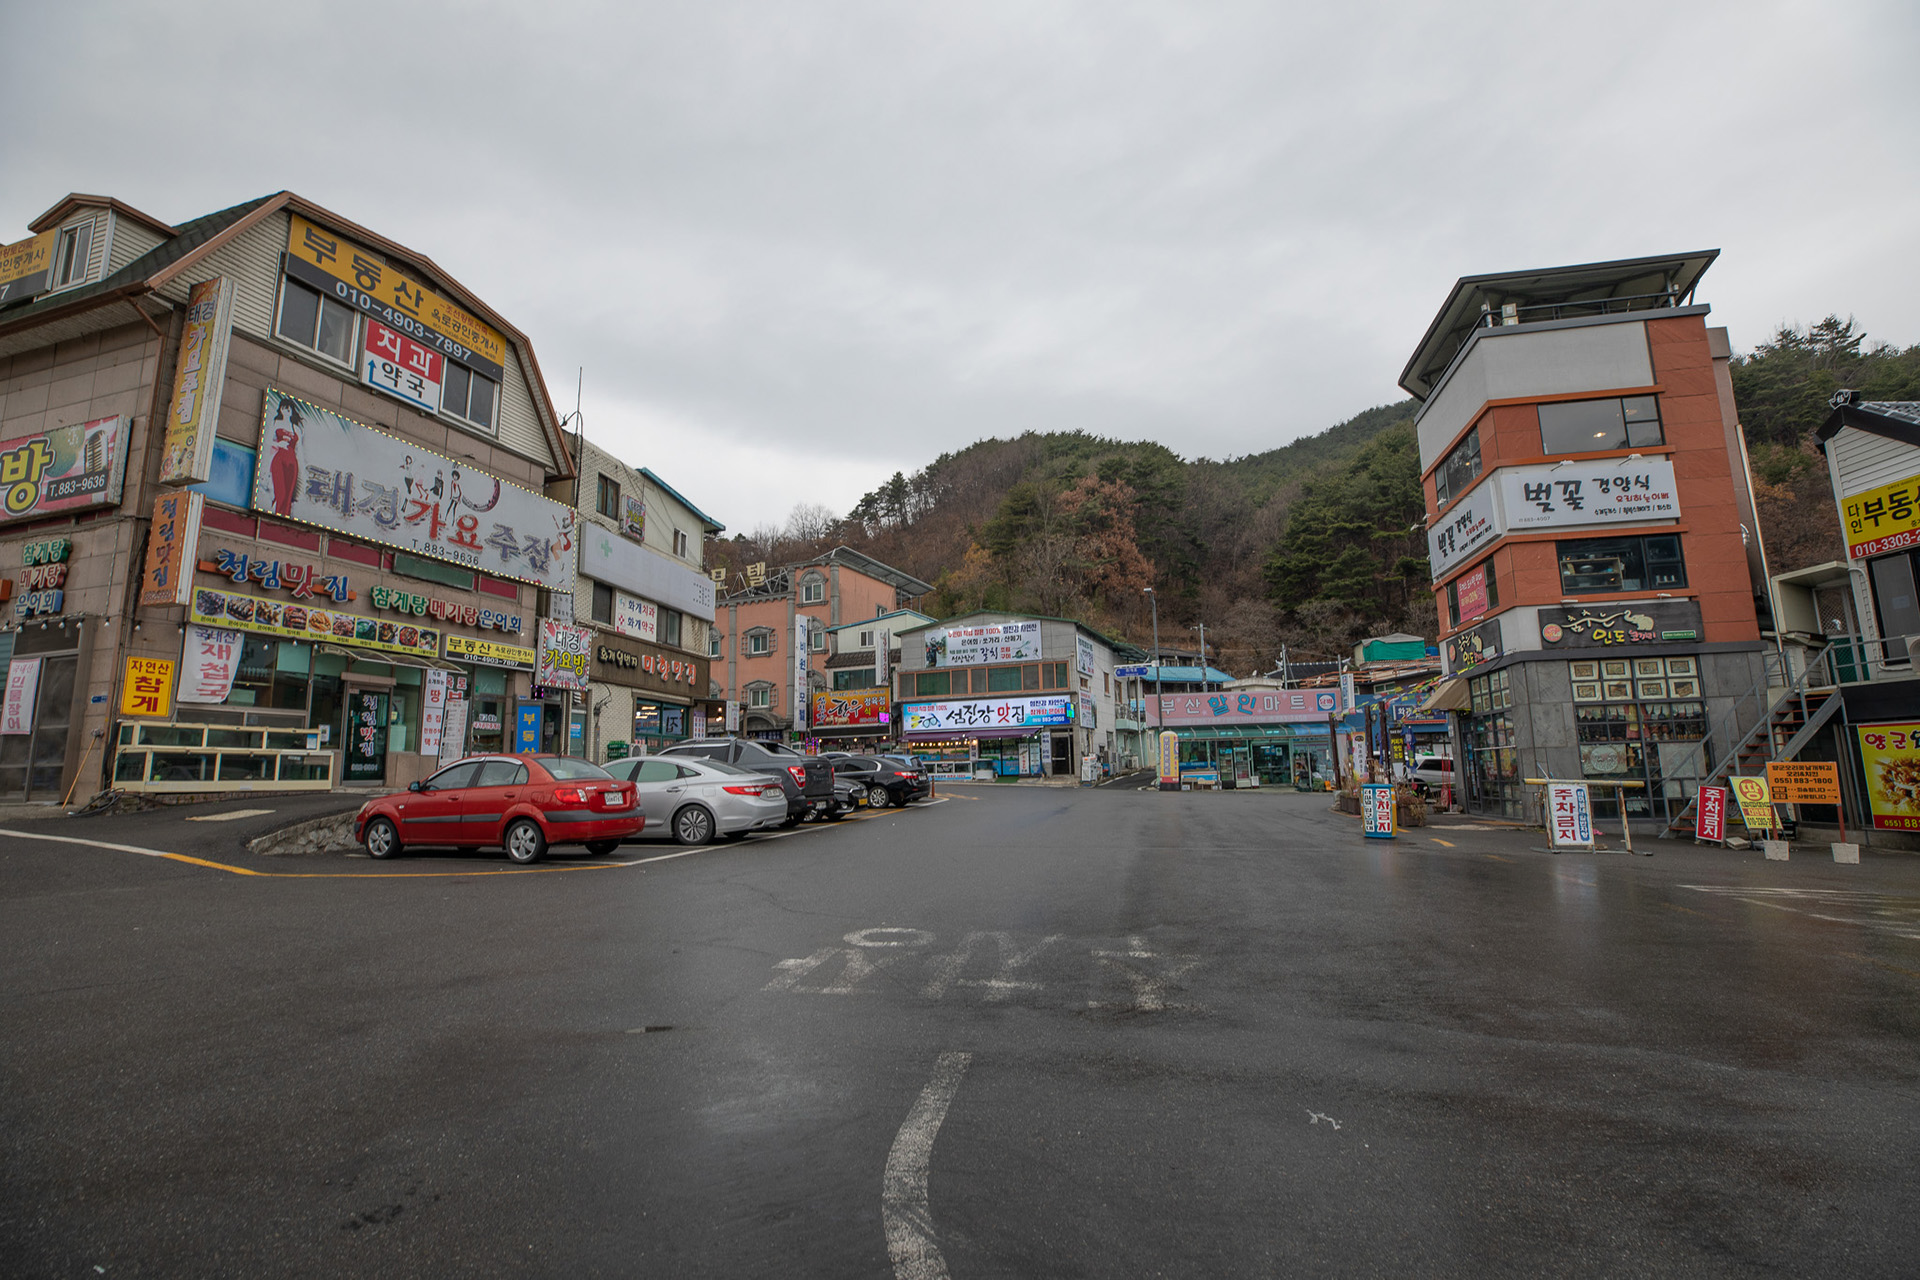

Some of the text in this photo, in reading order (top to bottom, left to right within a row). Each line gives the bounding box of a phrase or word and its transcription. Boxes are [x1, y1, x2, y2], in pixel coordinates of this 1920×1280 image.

[0, 247, 45, 273] 인중개사
[303, 227, 424, 317] 부동산
[187, 301, 217, 323] 태경
[336, 281, 471, 361] 010-4903-7897
[376, 328, 434, 377] 치과
[175, 326, 207, 425] 가요주점
[381, 362, 426, 399] 약국
[1, 442, 52, 512] 방
[50, 474, 106, 497] T.883-9636
[1592, 474, 1650, 493] 경양식
[23, 538, 66, 566] 참게탕
[151, 498, 178, 587] 청림맛집
[411, 538, 480, 566] T.883-9636
[19, 563, 62, 589] 메기탕
[217, 548, 350, 602] 청림맛집
[711, 562, 766, 591] 모텔
[15, 588, 57, 616] 은어회
[373, 585, 523, 635] 참게탕 메기탕 은어회
[194, 627, 237, 644] 국내산
[985, 627, 1001, 635] 100%
[1593, 628, 1625, 644] 인도
[449, 637, 491, 656] 부동산
[464, 653, 519, 667] 010-4903-7897
[980, 647, 998, 662] 갈치
[131, 660, 169, 676] 자연산
[196, 642, 232, 700] 재첩국
[545, 647, 587, 677] 가요방
[642, 654, 697, 685] 미향맛집
[7, 675, 26, 730] 민물장어
[131, 675, 164, 713] 참게
[430, 689, 441, 703] 땅
[828, 698, 863, 718] 한우
[864, 696, 886, 707] 정육점
[946, 702, 1026, 726] 섬진강 맛집
[1741, 782, 1761, 800] 땅
[1376, 789, 1391, 832] 주차금지
[1554, 788, 1577, 841] 주차금지
[1703, 788, 1721, 839] 주차금지
